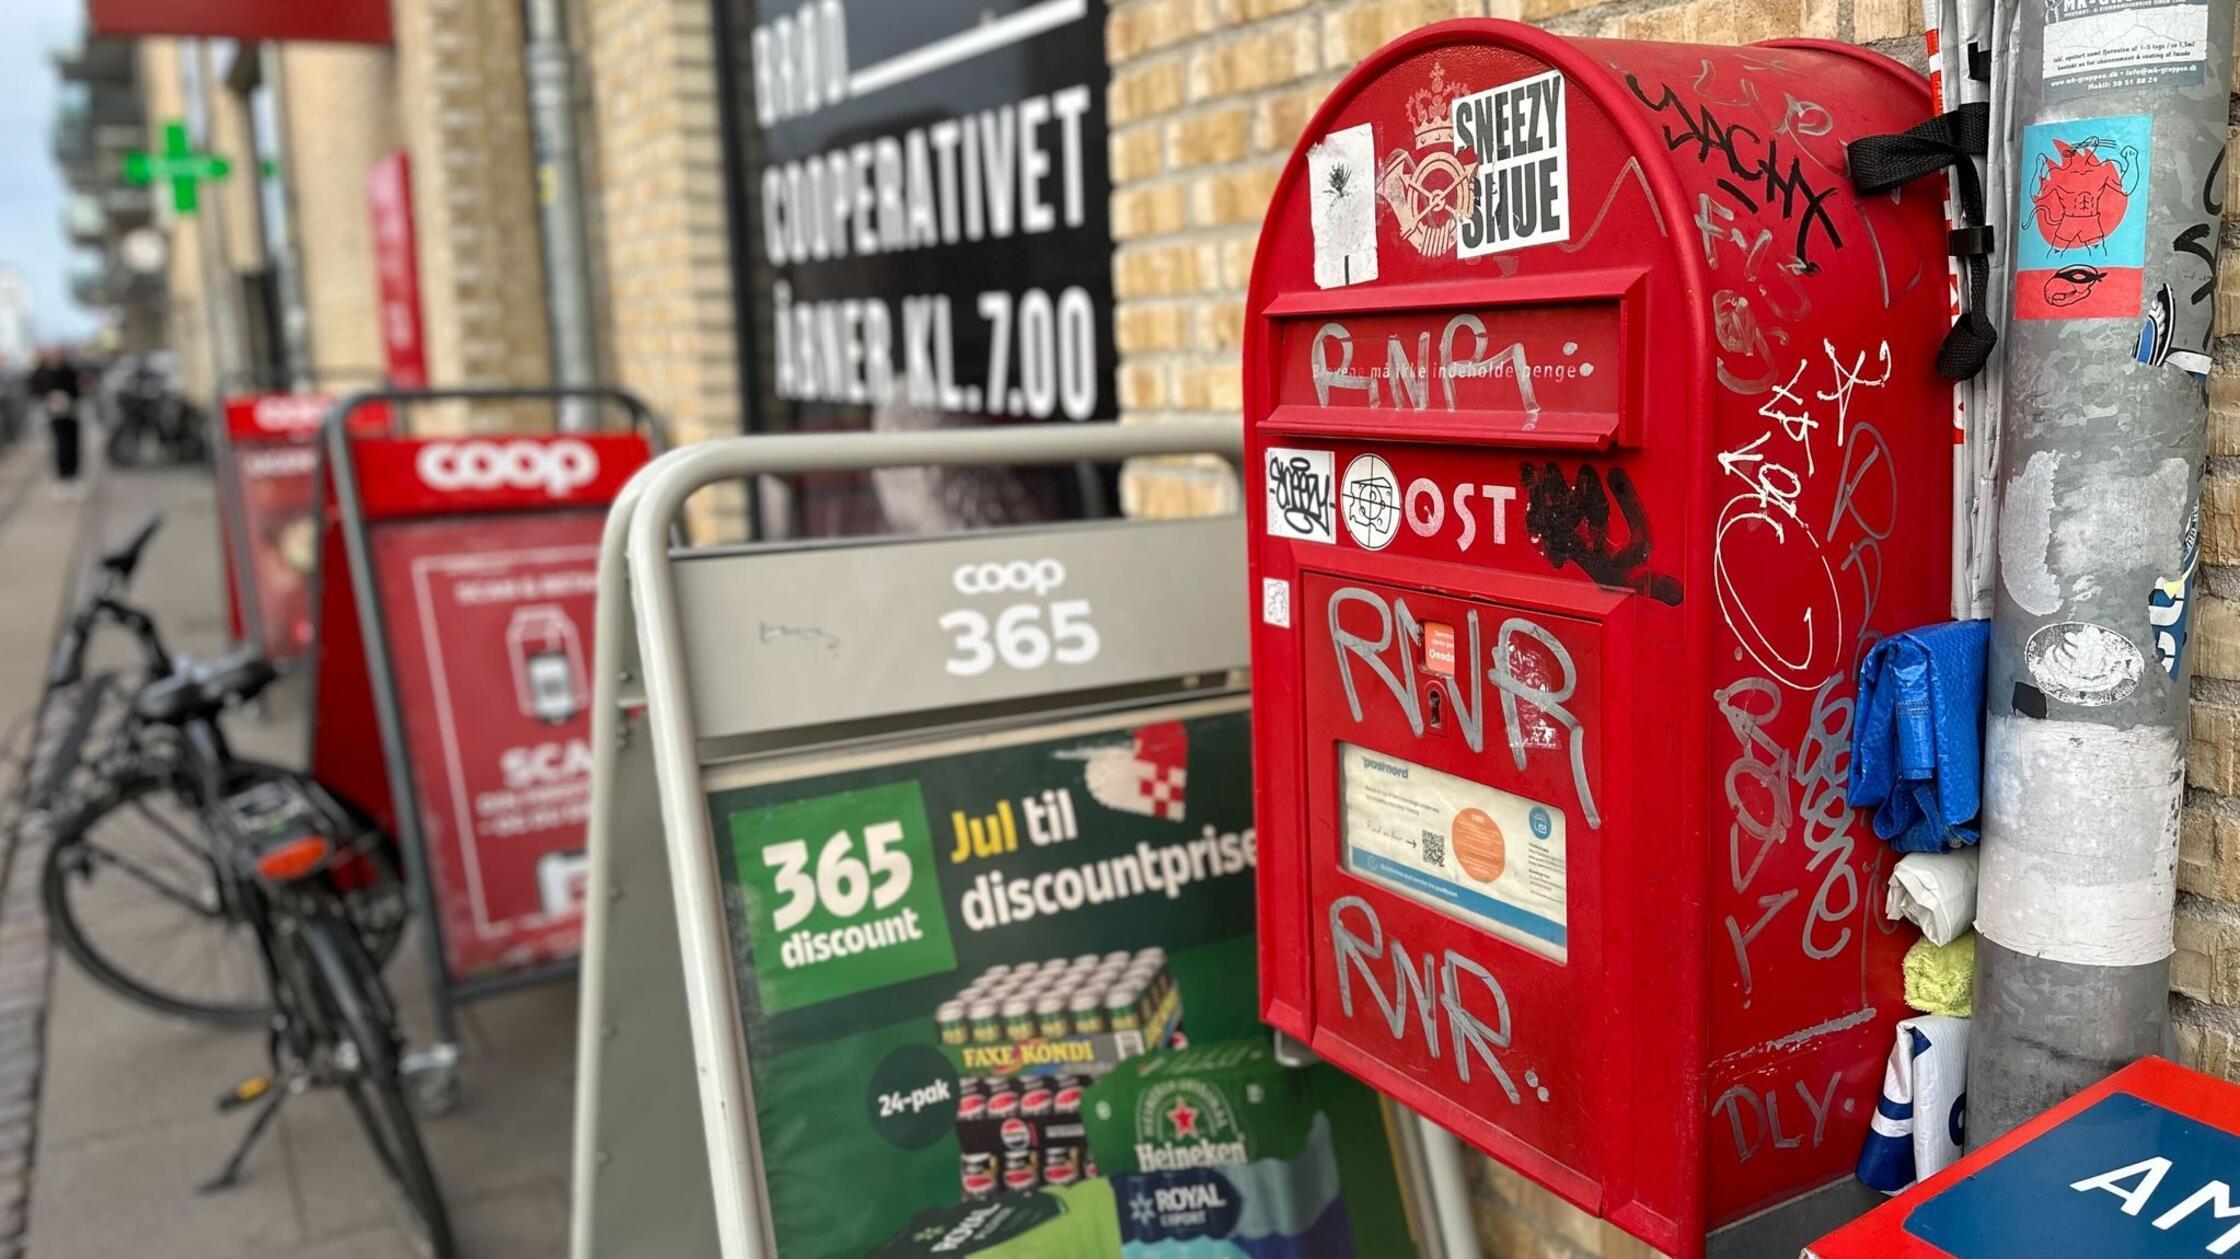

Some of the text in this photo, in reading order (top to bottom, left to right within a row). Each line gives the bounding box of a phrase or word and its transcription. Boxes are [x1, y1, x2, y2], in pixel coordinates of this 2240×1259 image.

[1455, 76, 1561, 165] SNEEZY
[762, 84, 1091, 267] COOPERATIVET
[773, 279, 1097, 422] ÅBNER KL. 7.00
[1432, 361, 1514, 380] indeholde
[1519, 364, 1577, 383] penge
[417, 440, 599, 498] coop
[953, 558, 1066, 596] coop
[939, 599, 1101, 678] 365
[1362, 756, 1409, 779] postnord
[950, 788, 1078, 864] Jul til
[762, 820, 913, 933] 365
[780, 906, 923, 969] discount
[962, 1044, 1015, 1069] FAXE
[878, 1078, 951, 1118] 24-pak
[1134, 1137, 1250, 1174] Heineken
[1154, 1182, 1228, 1213] ROYAL
